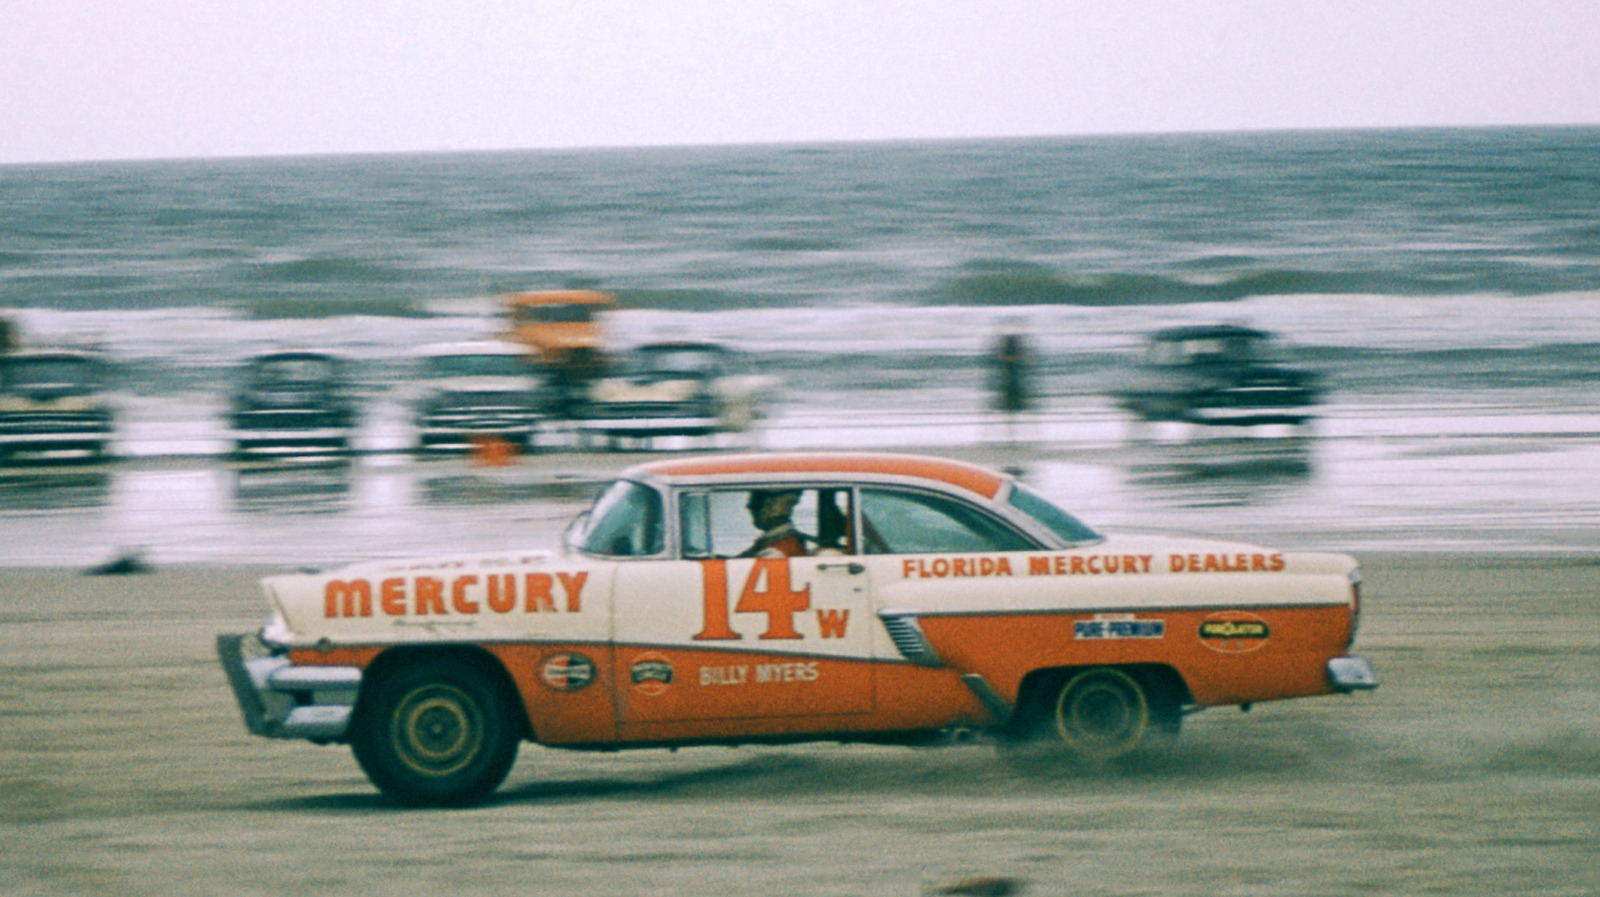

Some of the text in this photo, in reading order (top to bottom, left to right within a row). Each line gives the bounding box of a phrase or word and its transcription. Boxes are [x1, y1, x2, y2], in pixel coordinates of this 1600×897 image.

[903, 552, 1285, 579] FLORIDA MERCURY DEALERS
[325, 571, 588, 618] MERCURY
[691, 558, 810, 640] 14
[700, 661, 819, 685] BILLY MYERS
